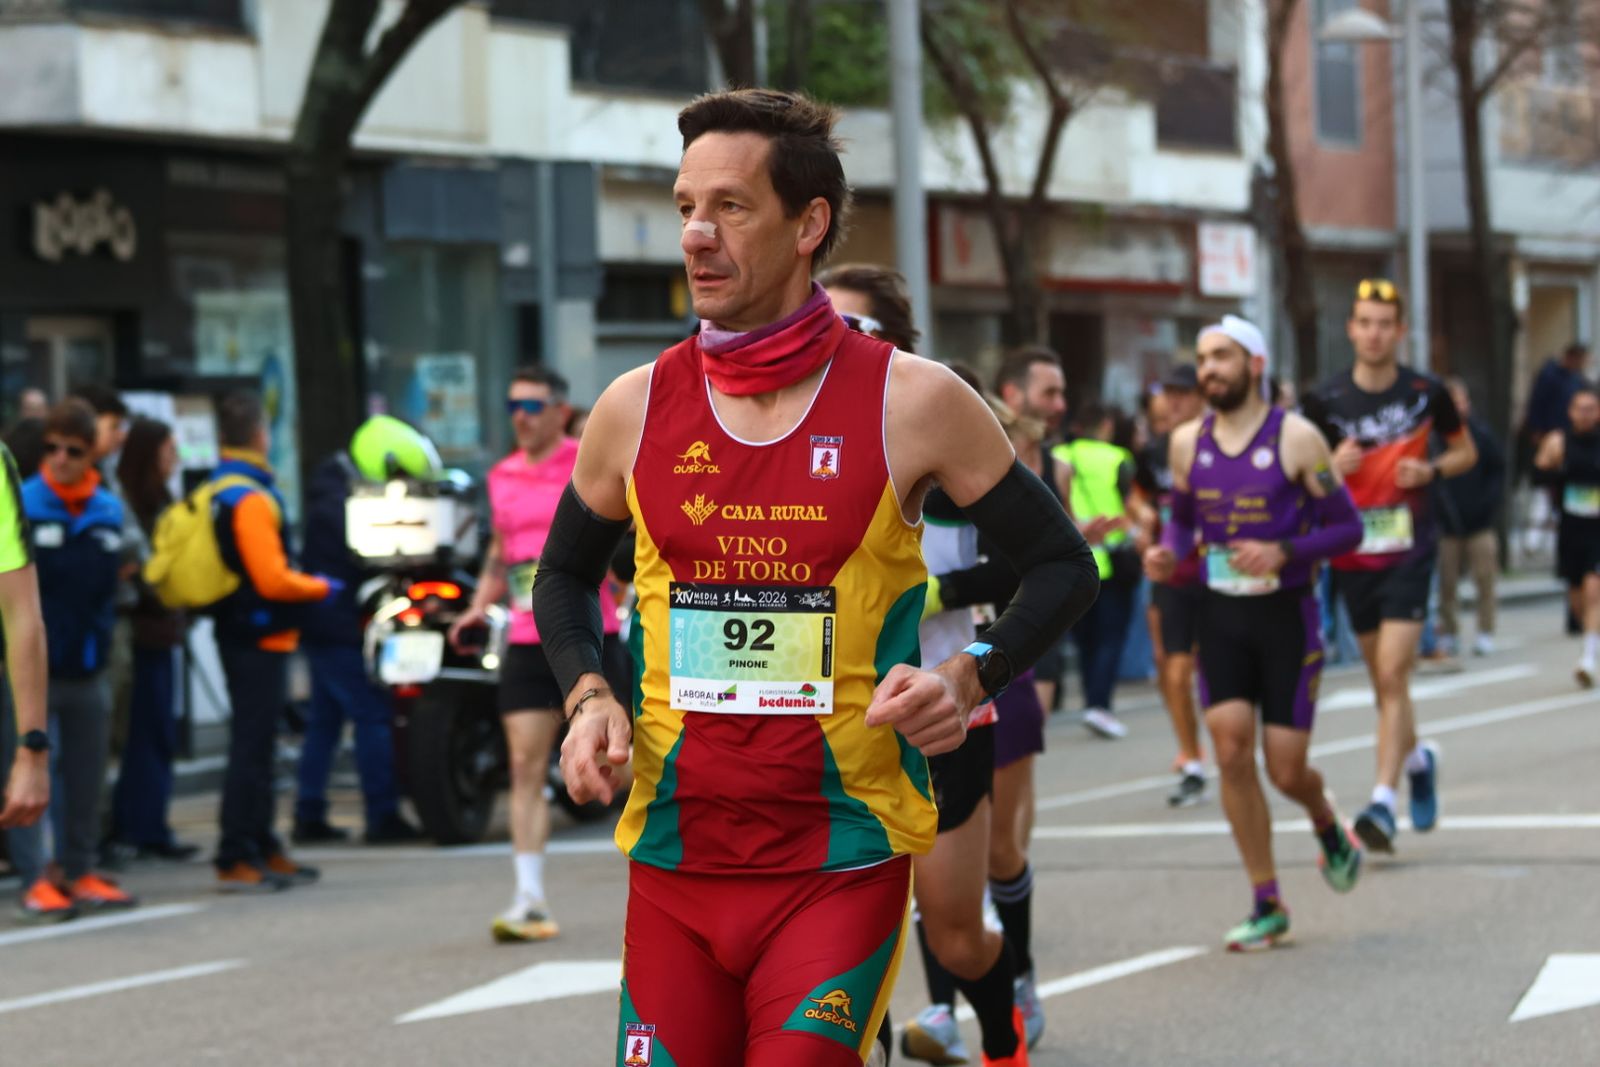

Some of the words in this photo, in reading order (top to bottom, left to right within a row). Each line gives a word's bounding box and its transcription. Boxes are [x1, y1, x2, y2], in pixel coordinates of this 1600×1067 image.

[673, 464, 721, 474] austral
[721, 505, 765, 521] CAJA
[769, 505, 828, 521] RURAL
[716, 535, 788, 556] VINO
[693, 560, 726, 580] DE
[733, 561, 811, 582] TORO
[675, 590, 694, 604] XIV
[694, 592, 718, 600] MEDIA
[758, 591, 787, 604] 2026
[723, 618, 775, 651] 92
[729, 660, 768, 669] PINONE
[678, 689, 716, 700] LABORAL
[804, 1008, 857, 1032] austral
